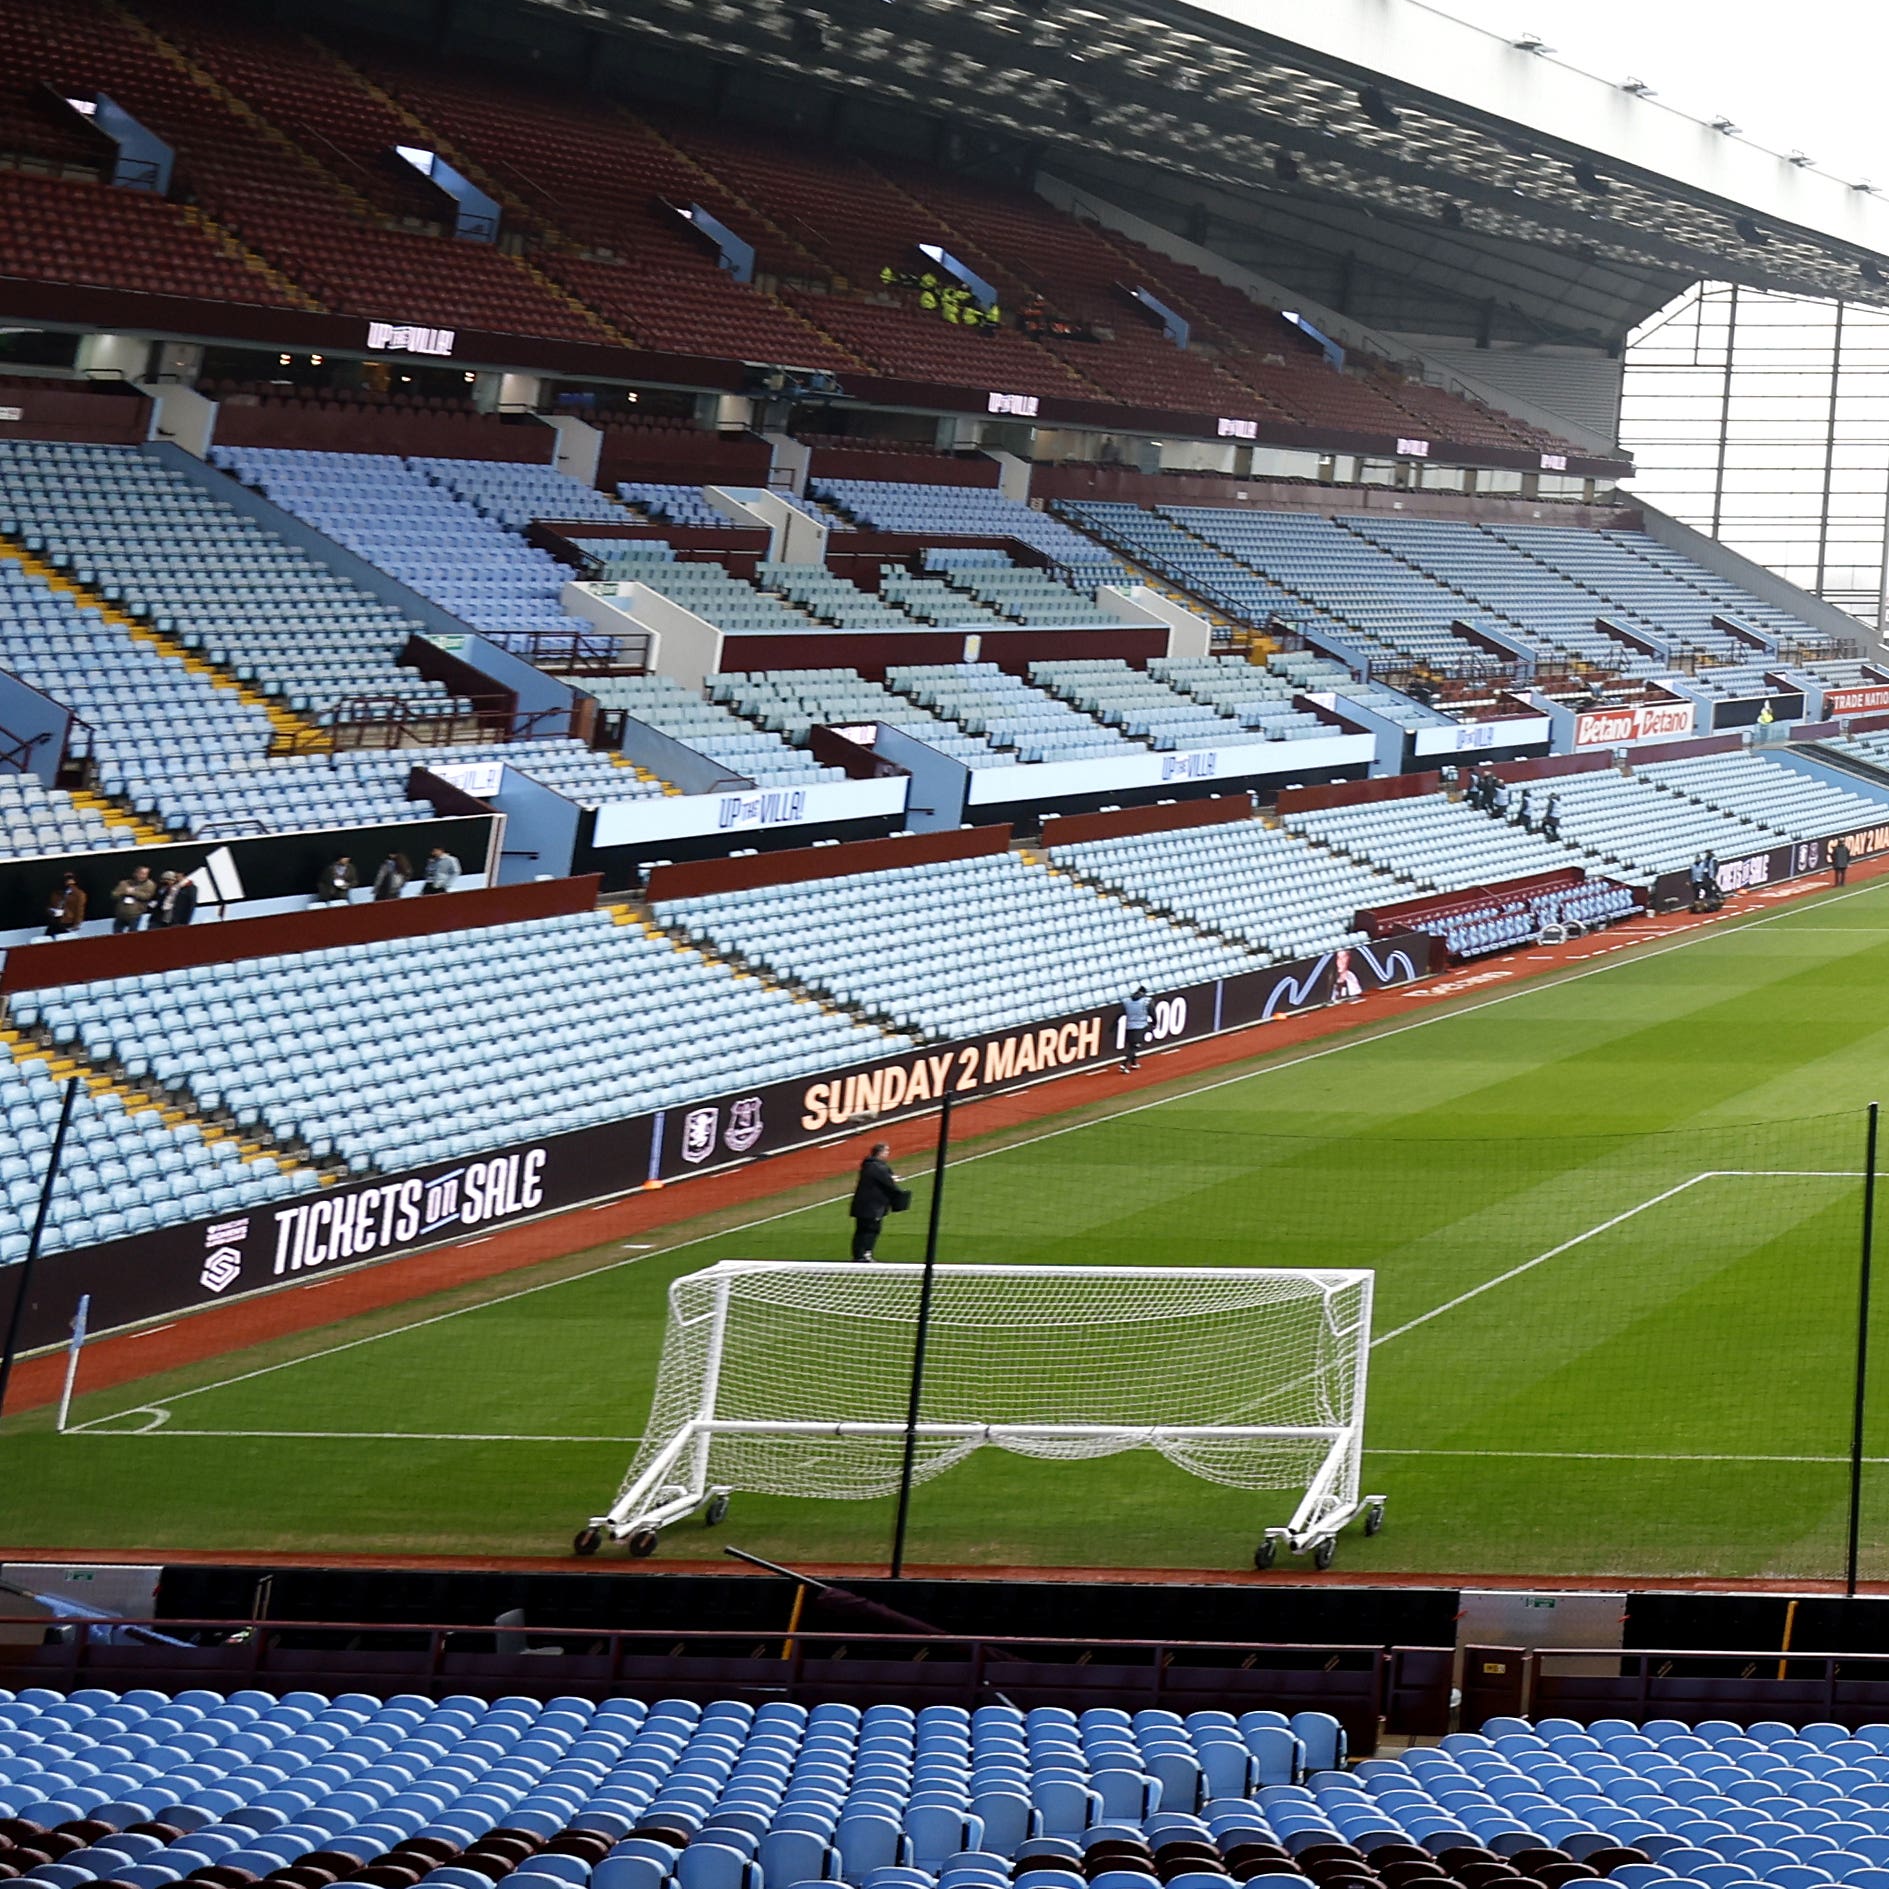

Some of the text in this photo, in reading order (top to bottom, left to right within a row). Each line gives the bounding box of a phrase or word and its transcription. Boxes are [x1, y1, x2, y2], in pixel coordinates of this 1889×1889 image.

[1834, 694, 1863, 710] TRADE
[1578, 709, 1689, 746] Betano Betano
[718, 797, 741, 828] UP
[759, 790, 808, 823] VILLA!
[801, 995, 1187, 1131] SUNDAY 2 MARCH 1:00
[273, 1178, 423, 1275] TICKETS
[461, 1148, 547, 1224] SALE
